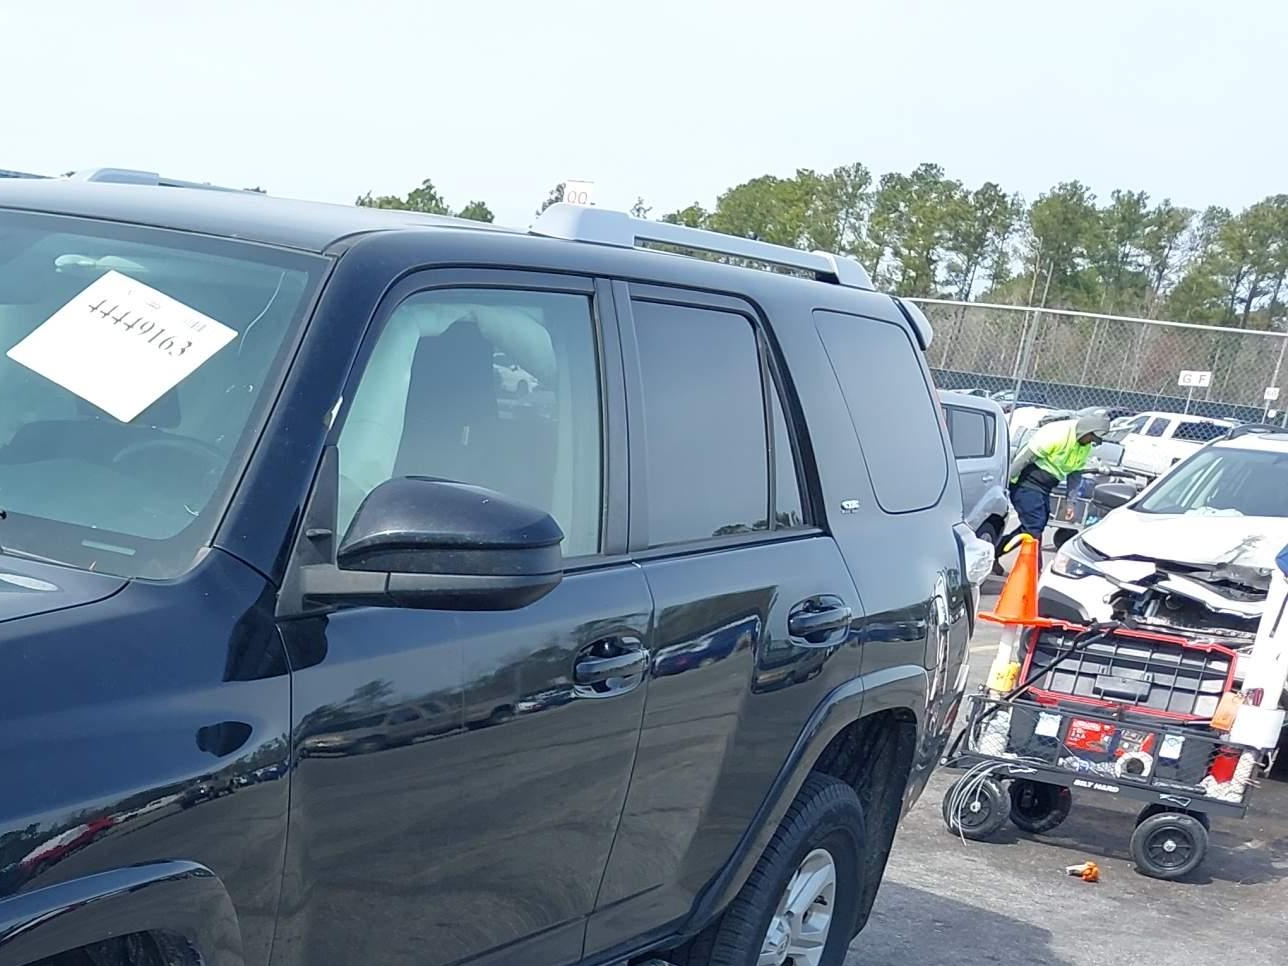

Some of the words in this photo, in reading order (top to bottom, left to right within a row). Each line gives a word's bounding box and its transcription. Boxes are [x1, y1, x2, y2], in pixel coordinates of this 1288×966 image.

[88, 299, 192, 357] 44449163
[1182, 373, 1193, 384] G
[1198, 374, 1208, 385] F
